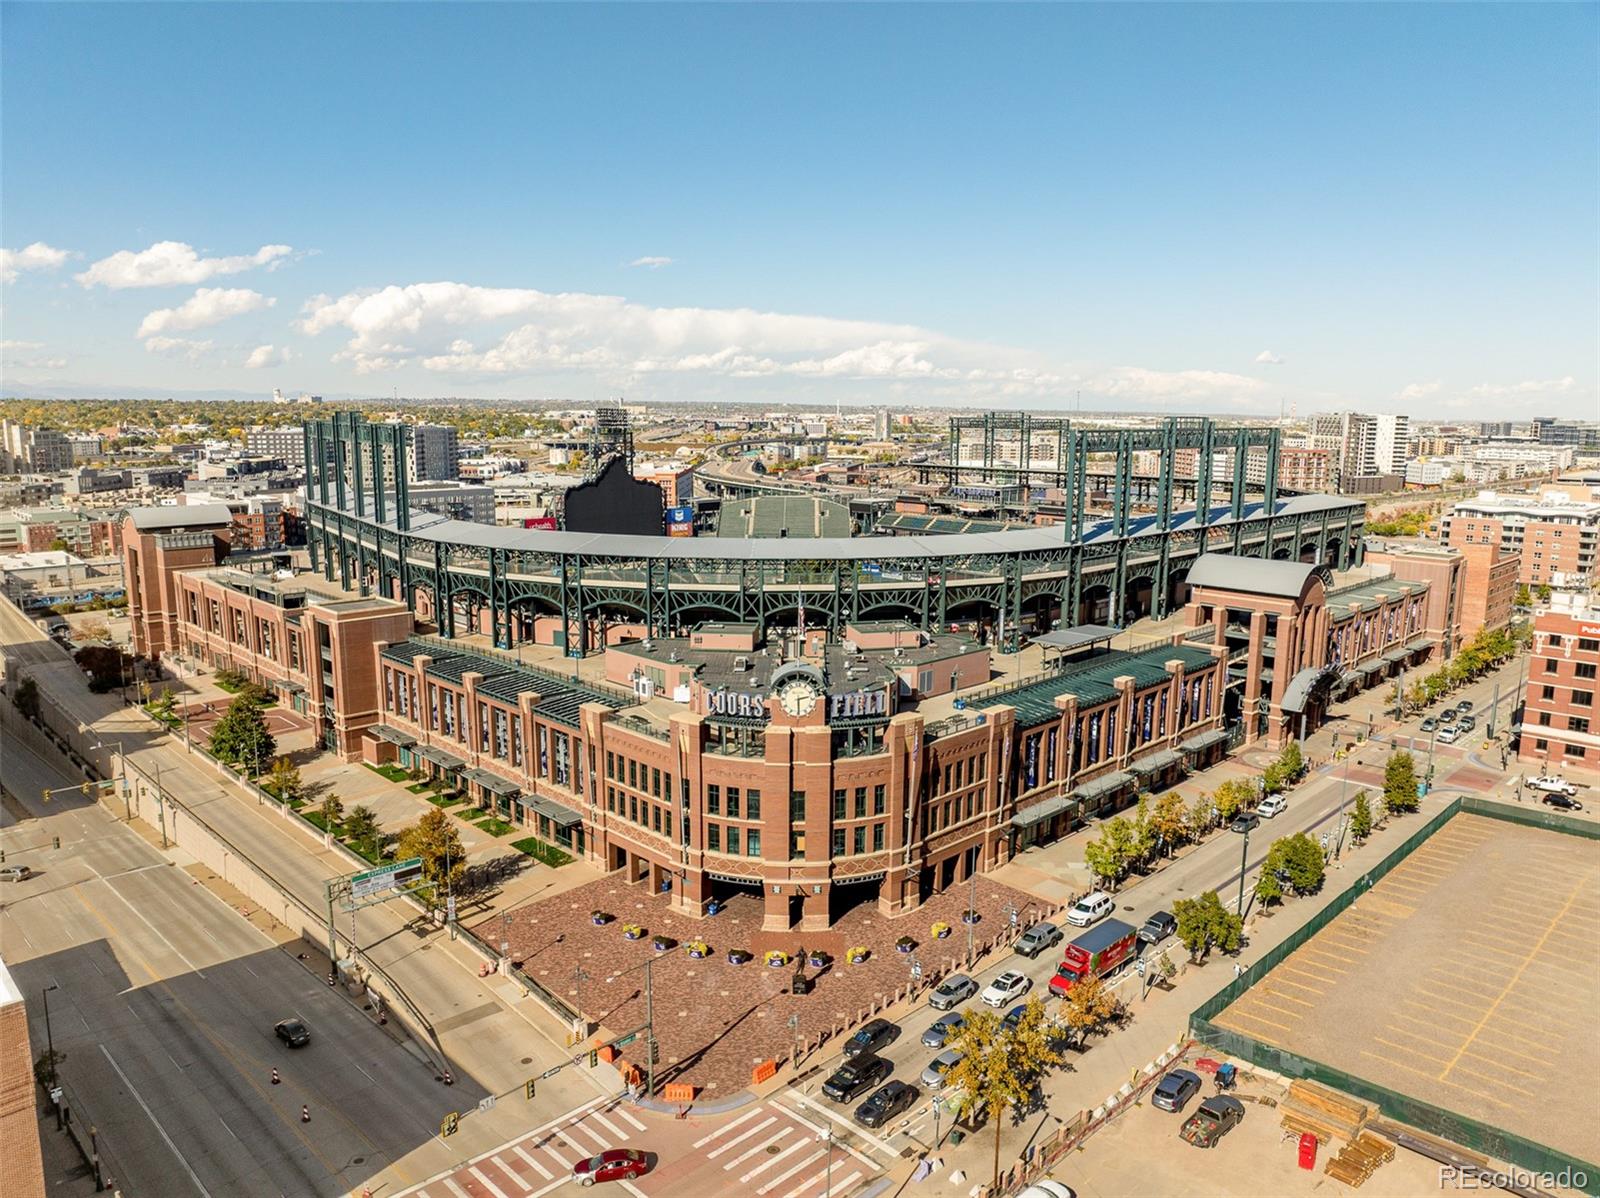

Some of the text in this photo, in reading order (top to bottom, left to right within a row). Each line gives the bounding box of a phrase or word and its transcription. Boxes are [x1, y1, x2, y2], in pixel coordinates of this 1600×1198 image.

[706, 690, 887, 717] COORS FIELD
[367, 867, 391, 878] EXPRESS
[392, 863, 406, 871] LANE
